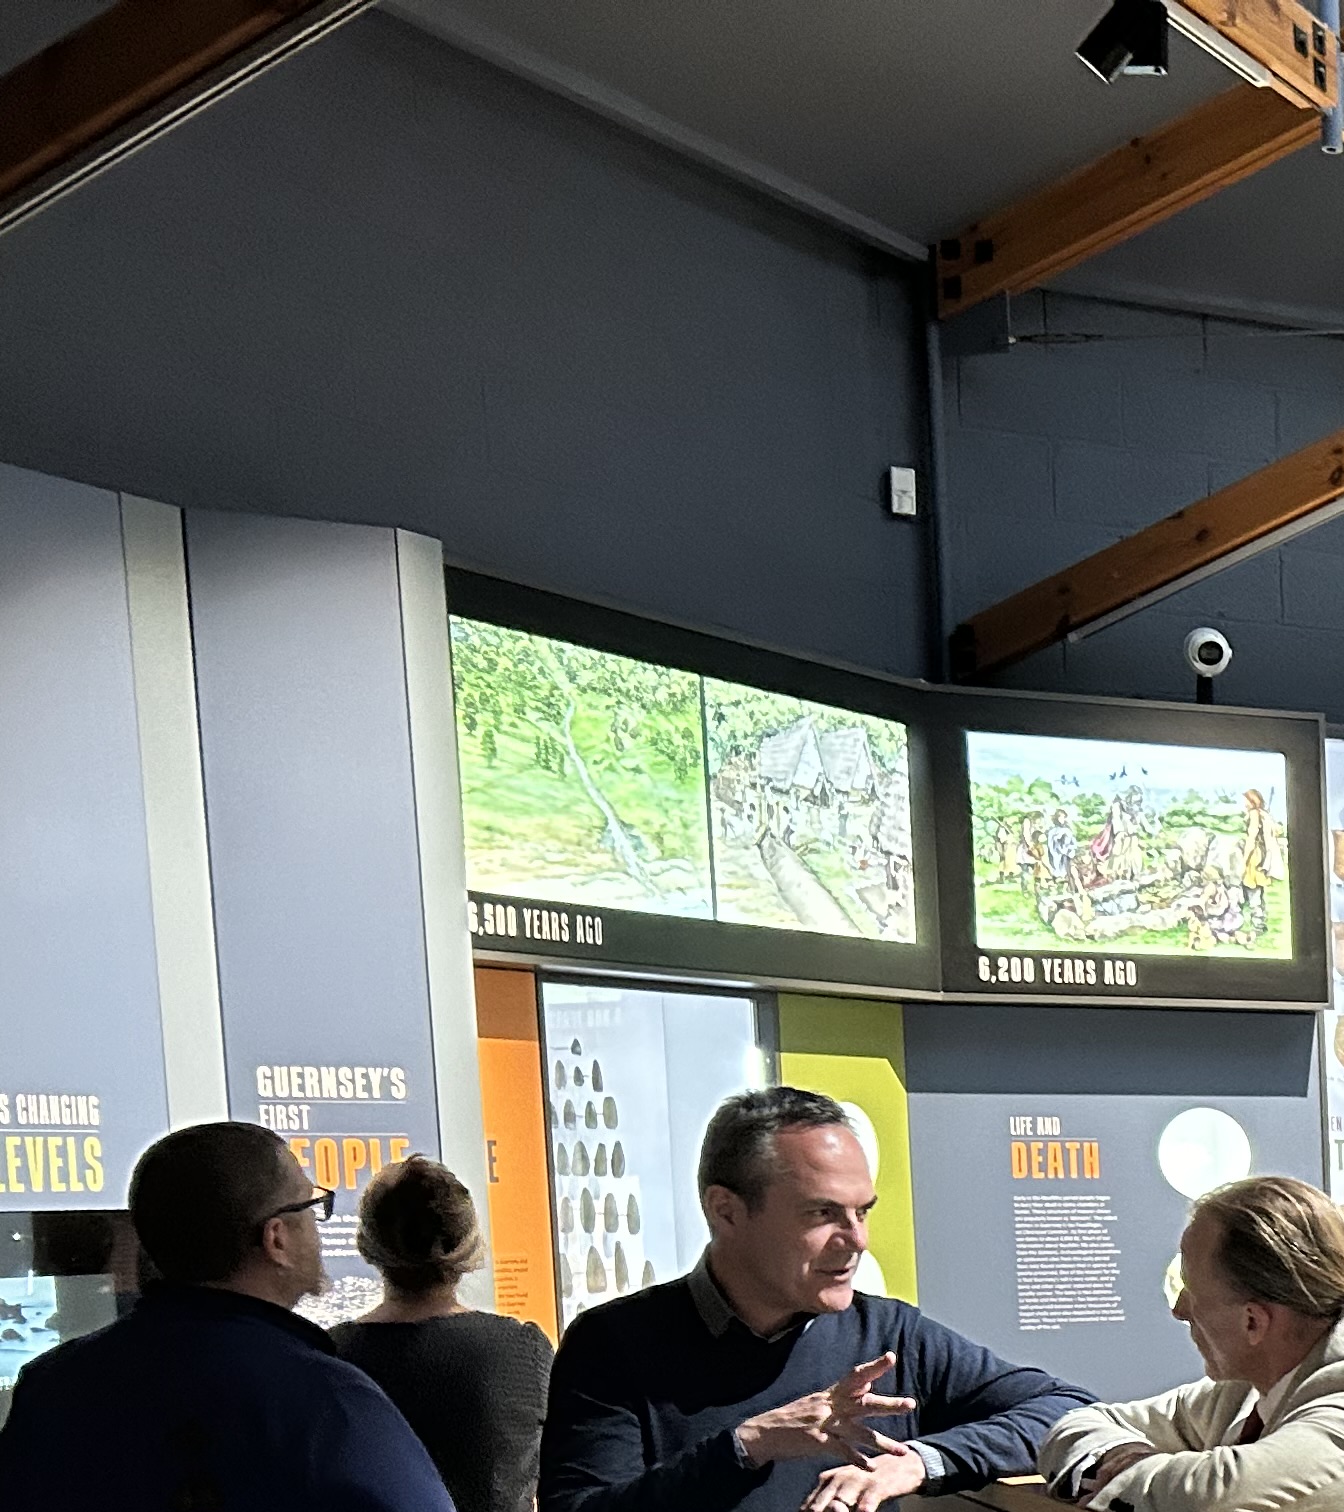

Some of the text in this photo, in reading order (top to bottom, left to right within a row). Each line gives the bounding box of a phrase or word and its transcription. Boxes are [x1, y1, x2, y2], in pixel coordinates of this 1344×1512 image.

[523, 907, 569, 942] YEARS
[576, 914, 603, 945] AGO
[978, 955, 1137, 986] 6,200 YEARS AGO
[256, 1065, 406, 1099] GUERNSEY'S
[16, 1093, 100, 1126] CHANGING
[259, 1104, 310, 1130] FIRST
[1009, 1116, 1060, 1135] LIFE AND
[0, 1136, 104, 1192] EVELS
[1011, 1141, 1100, 1179] DEATH
